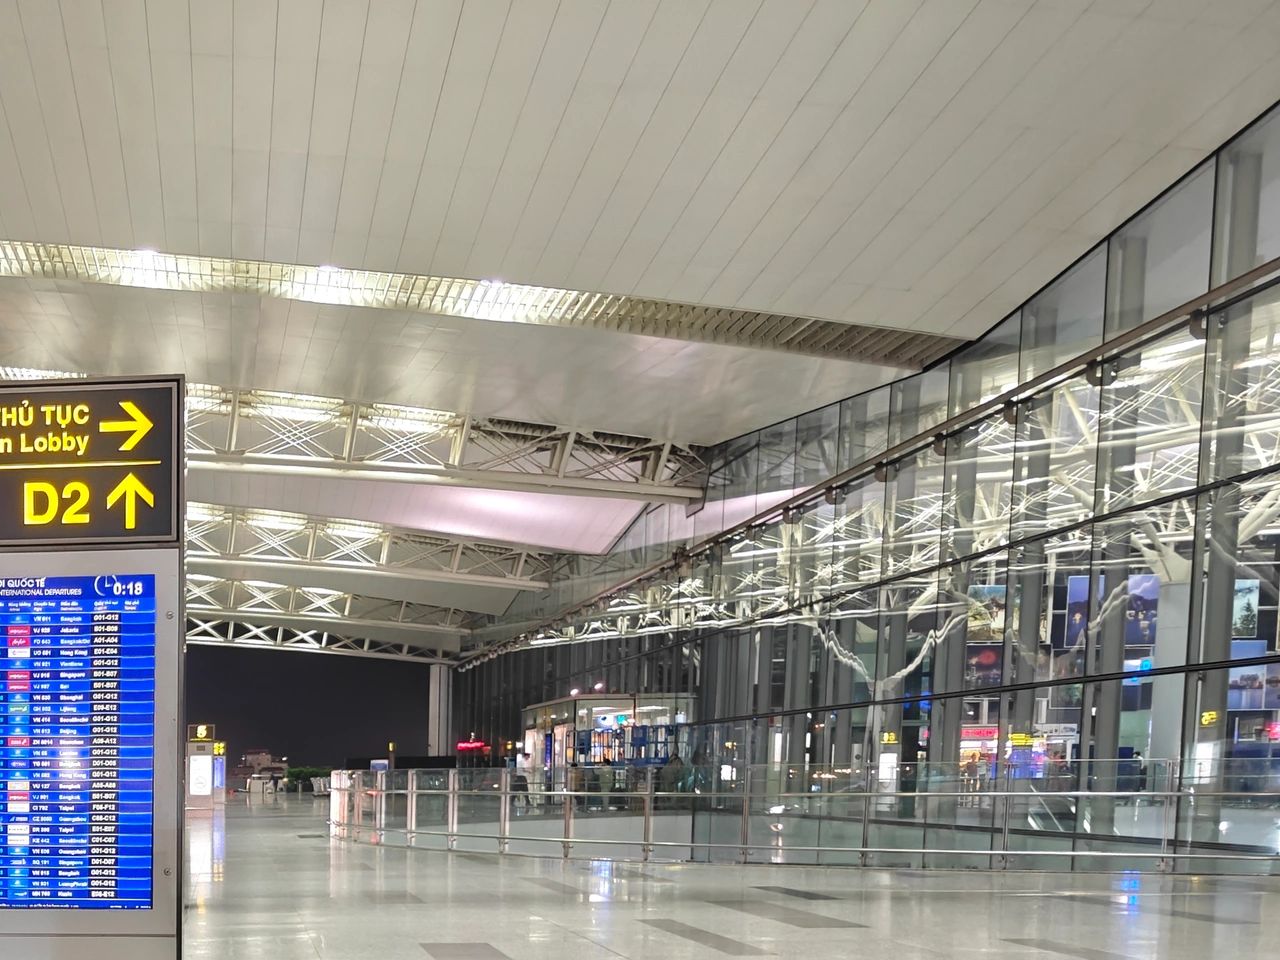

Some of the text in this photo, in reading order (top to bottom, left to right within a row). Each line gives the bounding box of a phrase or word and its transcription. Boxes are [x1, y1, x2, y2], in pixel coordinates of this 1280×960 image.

[40, 405, 90, 428] TỤC
[20, 432, 89, 455] Lobby
[23, 481, 90, 525] D2
[7, 578, 34, 587] QUỐC
[36, 577, 46, 587] TẾ
[113, 582, 143, 595] 0:18
[44, 588, 82, 596] DEPARTURES
